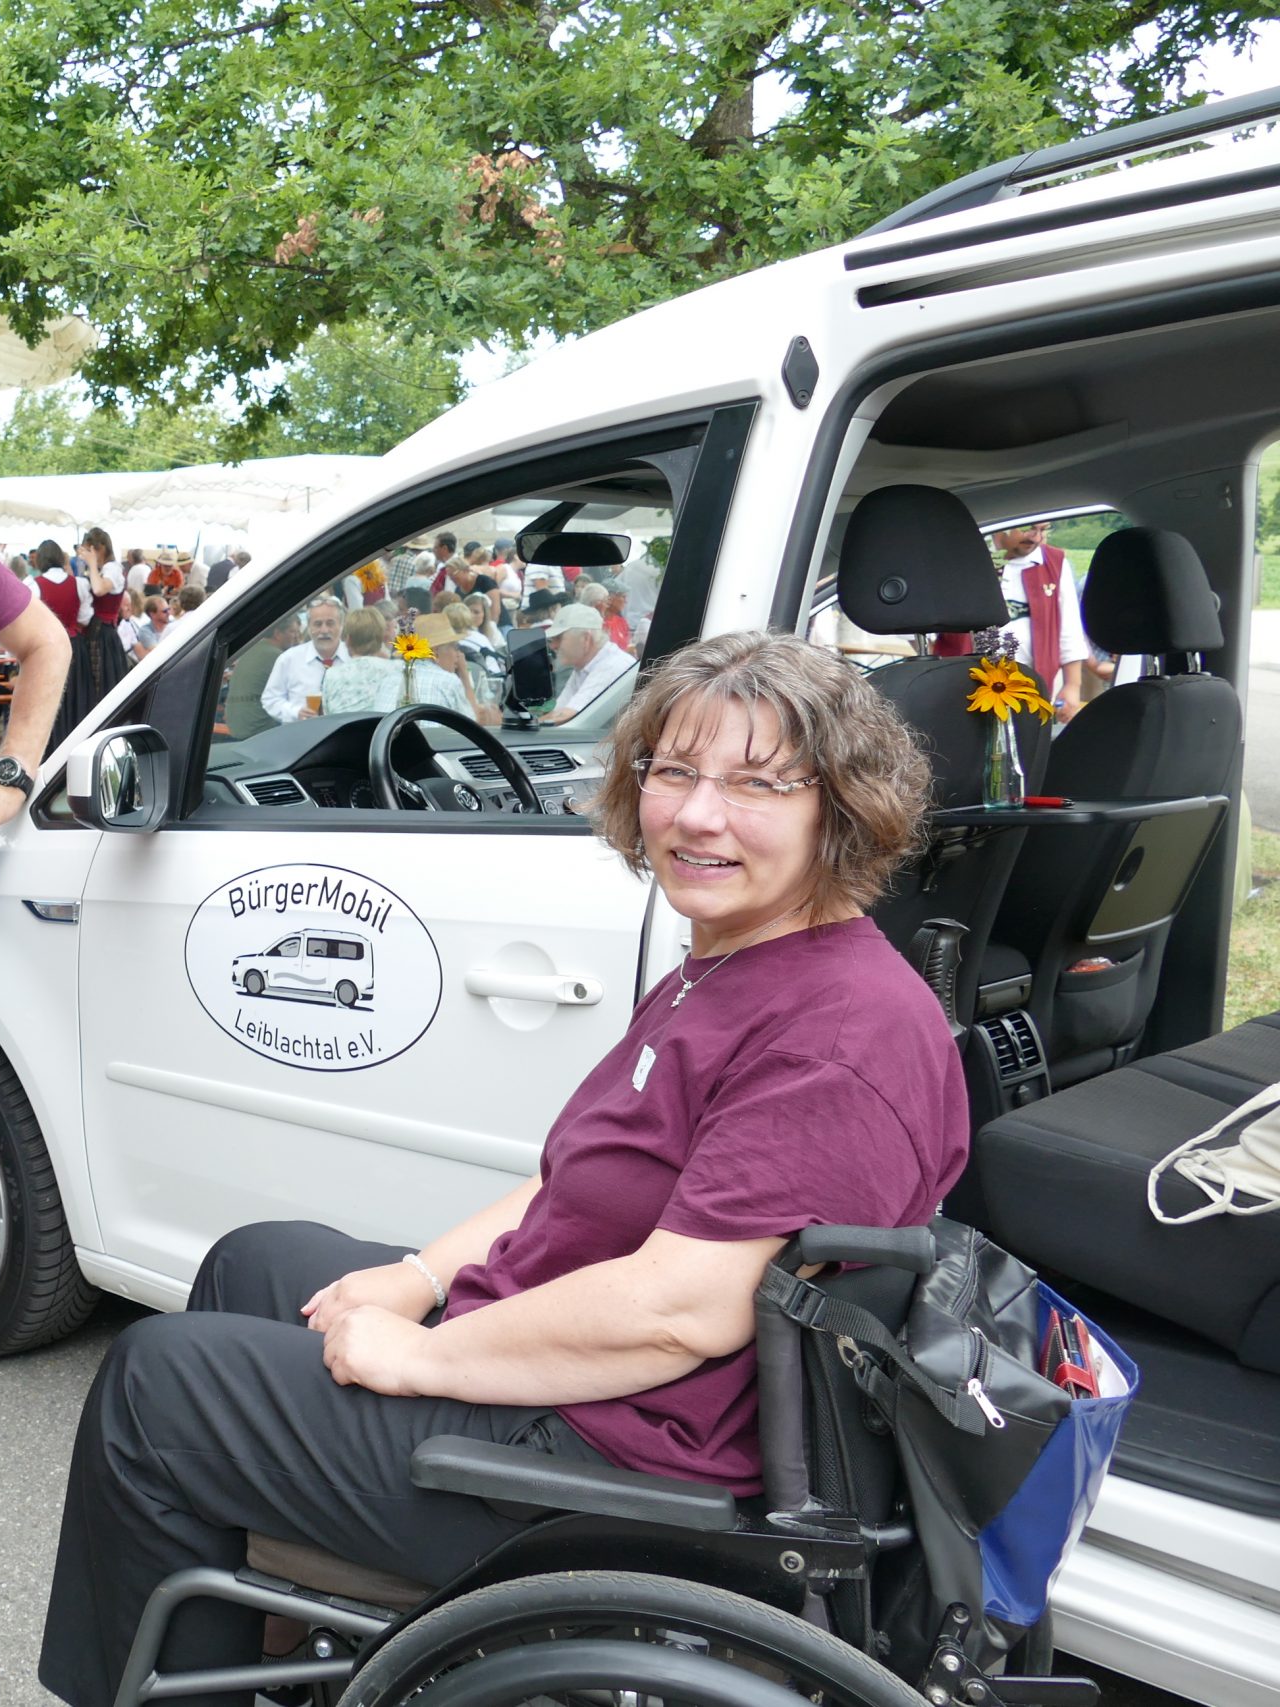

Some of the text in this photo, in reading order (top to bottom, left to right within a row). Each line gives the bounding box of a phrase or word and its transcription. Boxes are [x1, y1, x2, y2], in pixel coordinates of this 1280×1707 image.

[228, 876, 392, 933] BürgerMobil
[234, 1008, 382, 1060] Leiblachtal e.V.
